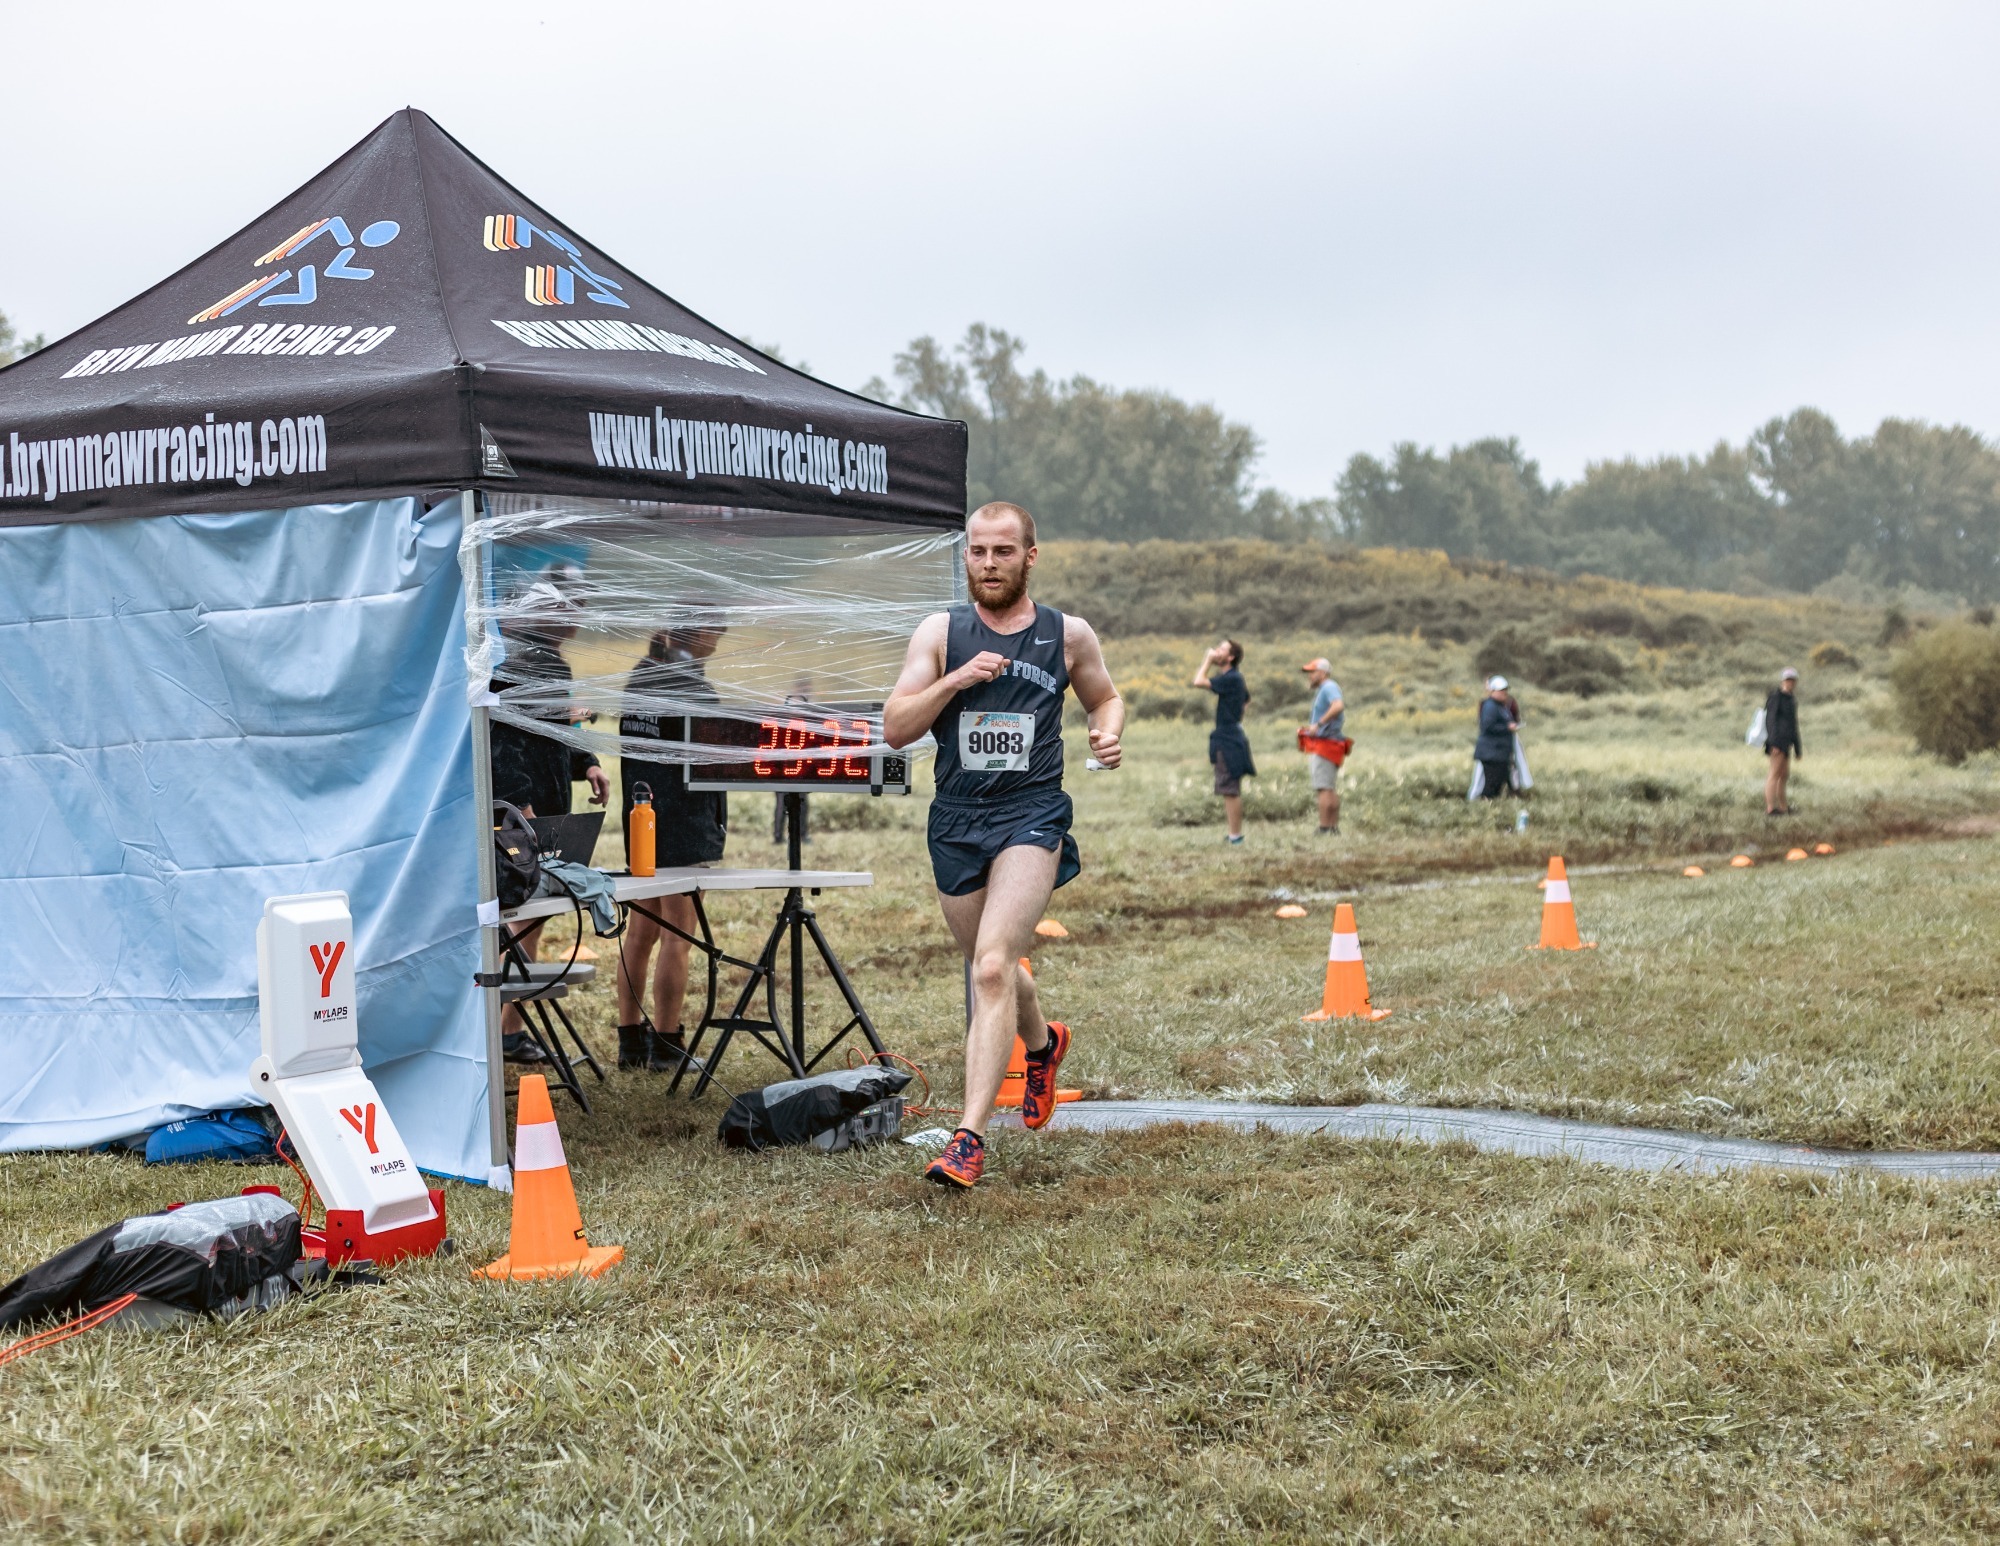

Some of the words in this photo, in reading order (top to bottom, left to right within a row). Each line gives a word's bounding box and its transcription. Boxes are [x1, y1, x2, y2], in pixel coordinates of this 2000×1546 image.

[59, 342, 160, 379] BRYN
[133, 325, 244, 369] MAWR
[221, 323, 353, 356] RACING
[333, 325, 397, 356] CO
[490, 320, 588, 349] BRYN
[556, 319, 662, 352] MAWR
[631, 322, 739, 368] RACING
[709, 343, 768, 376] CO
[0, 412, 327, 502] .brynmawrracing.com
[588, 406, 888, 496] www.brynmawrracing.com
[1012, 660, 1057, 694] FORGE
[990, 720, 1011, 728] RACING
[1012, 721, 1020, 729] CO
[968, 731, 1024, 755] 9083
[313, 1006, 348, 1020] MYLAPS
[370, 1159, 405, 1174] MYLAPS
